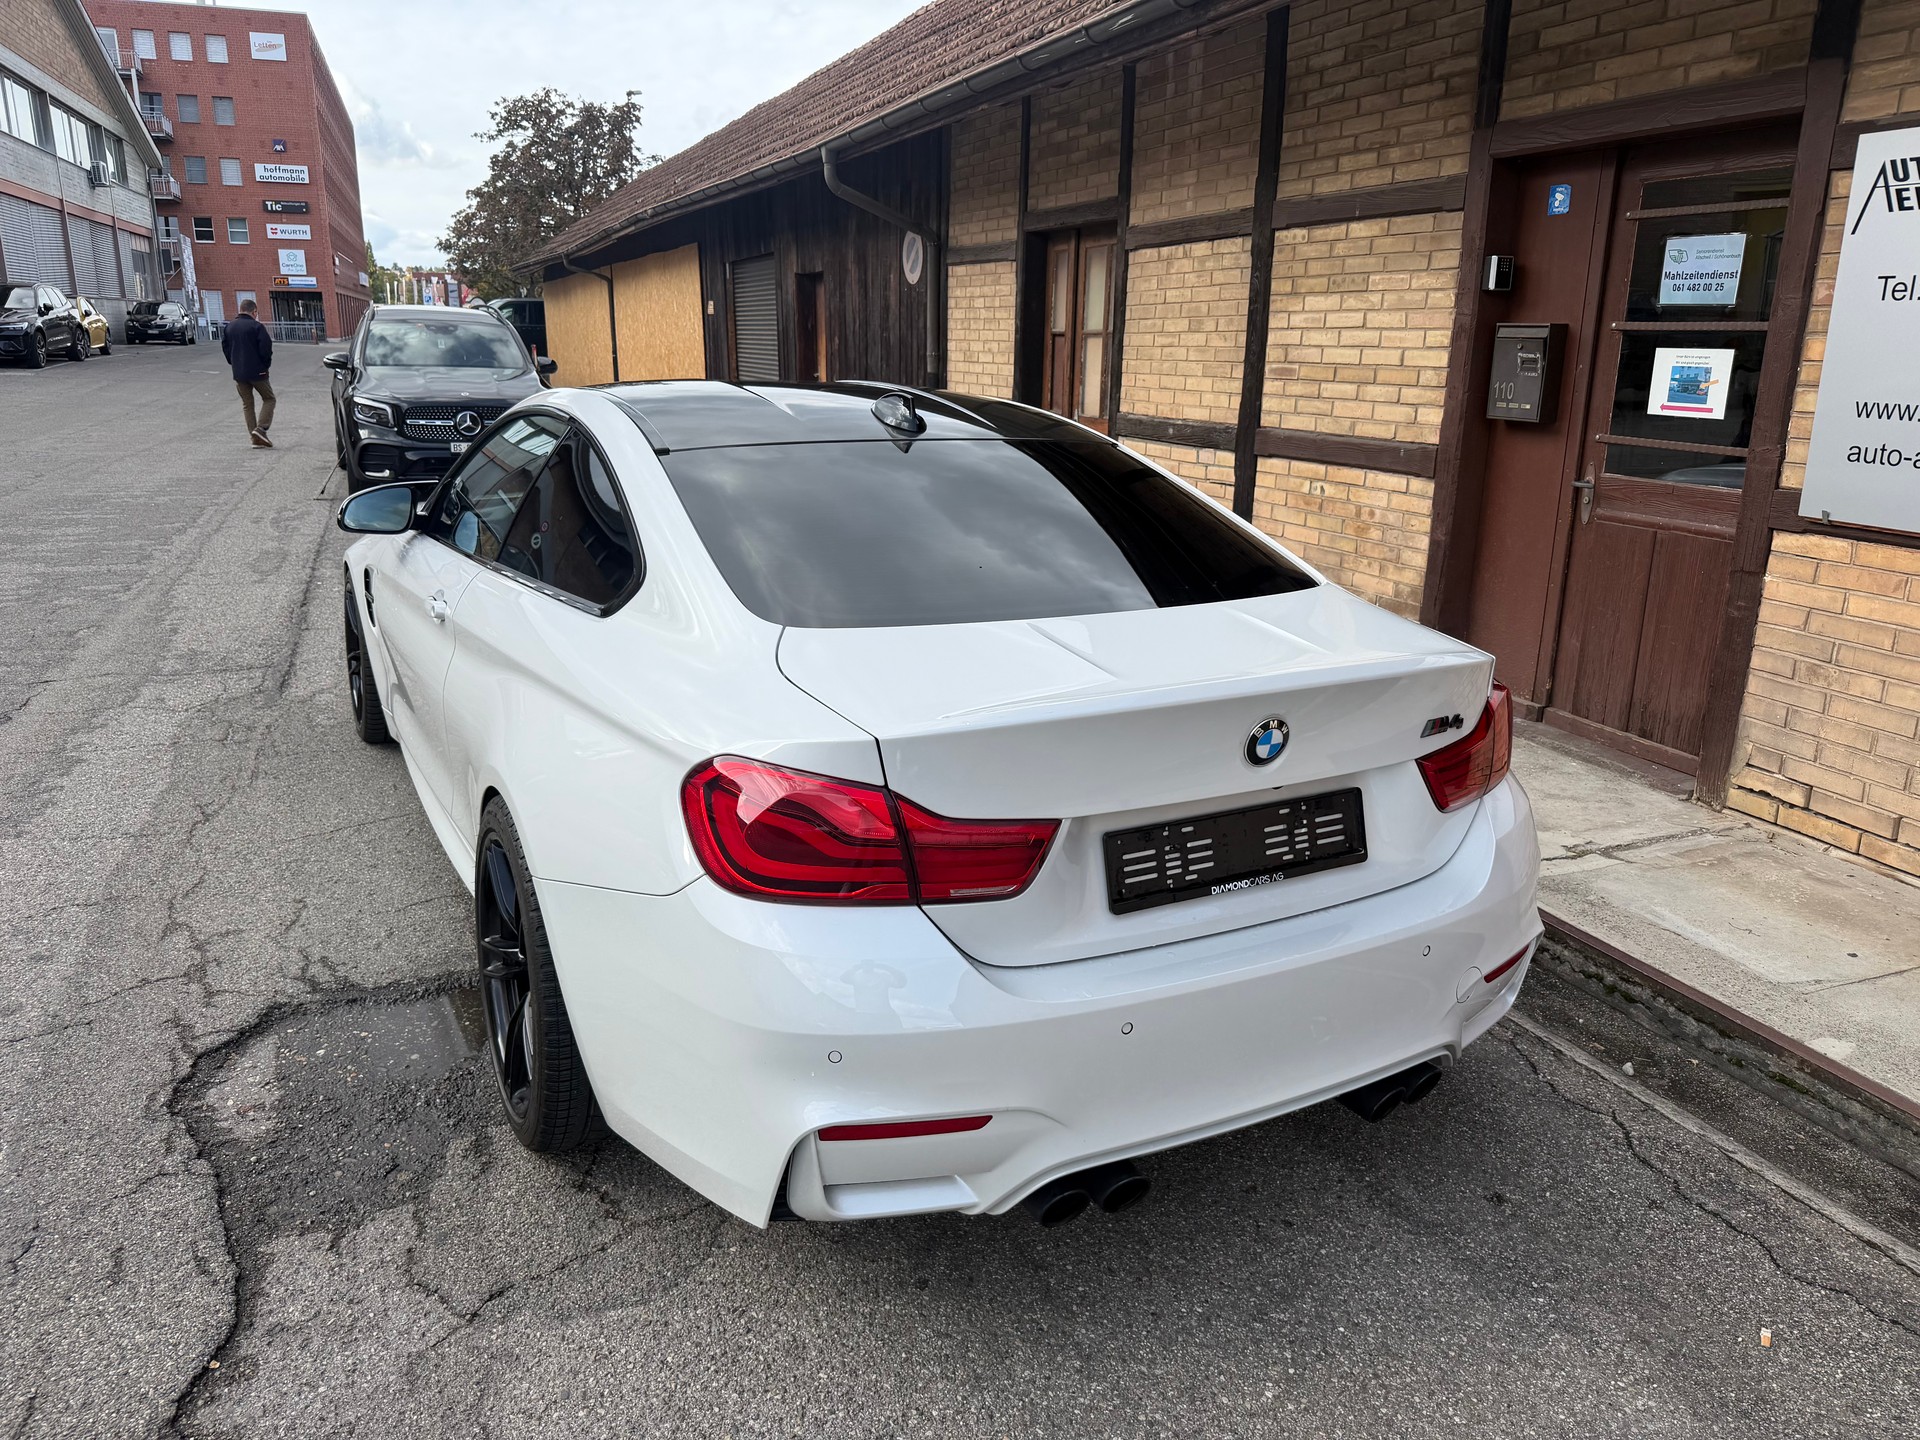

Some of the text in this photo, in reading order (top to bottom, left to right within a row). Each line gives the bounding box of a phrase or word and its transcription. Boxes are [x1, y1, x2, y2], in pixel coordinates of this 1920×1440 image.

[263, 165, 305, 175] hoffmann
[259, 174, 306, 182] automobile
[265, 201, 282, 211] Tic
[1663, 269, 1739, 281] Mahlzeitendienst
[1672, 282, 1725, 292] 061 482 00 25
[1494, 381, 1515, 400] 110
[1856, 401, 1920, 422] www.
[1211, 872, 1284, 895] DIAMONDCARS AG
